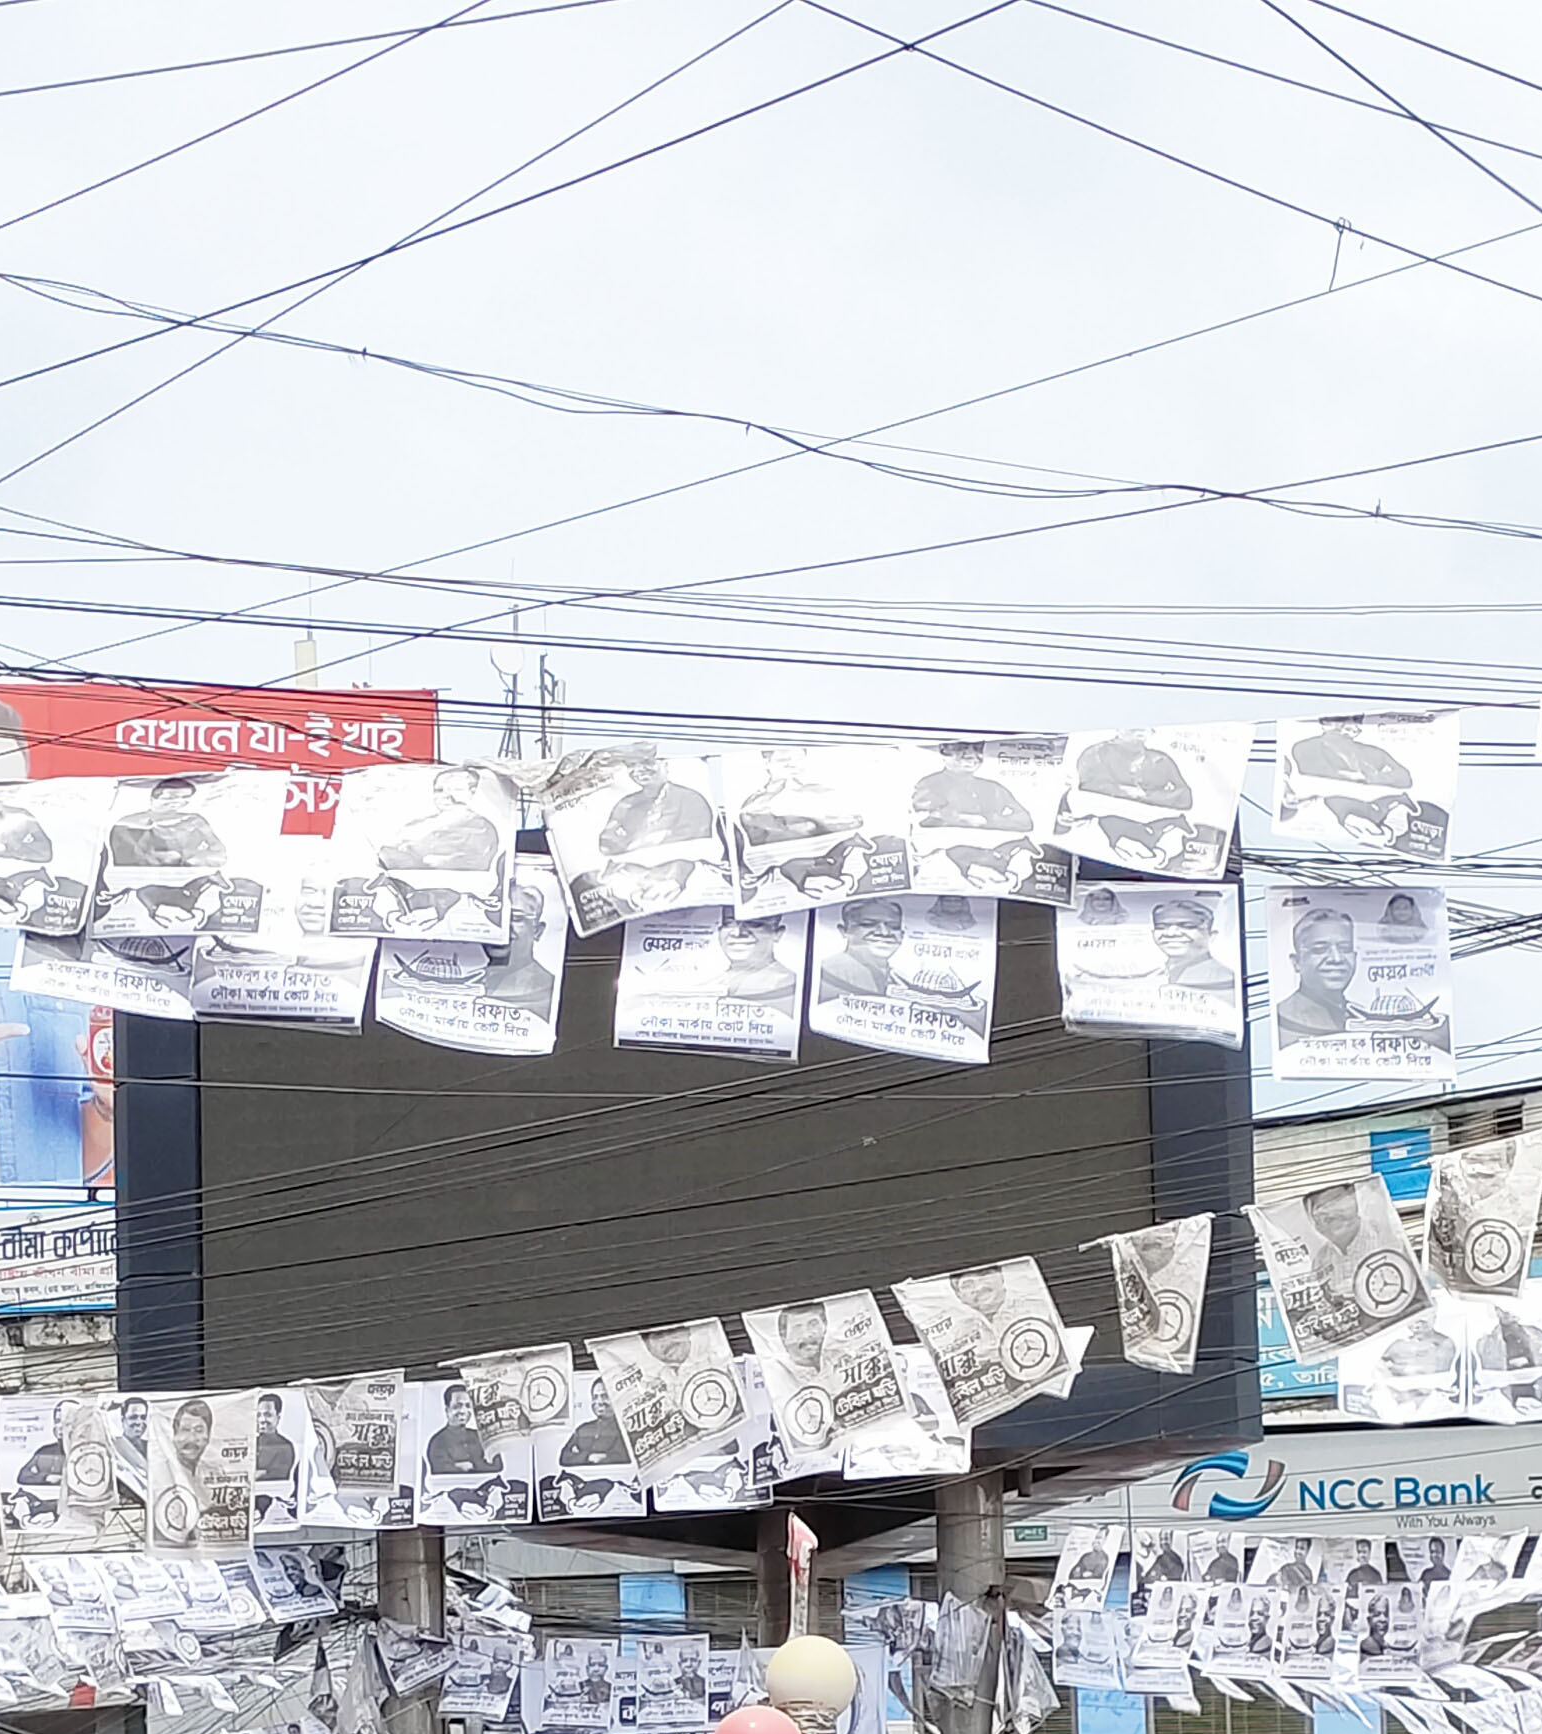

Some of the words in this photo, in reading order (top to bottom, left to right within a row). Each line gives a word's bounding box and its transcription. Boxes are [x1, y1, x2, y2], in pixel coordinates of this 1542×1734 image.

[115, 718, 241, 753] যেখানে
[341, 713, 407, 758] খাই
[869, 852, 904, 868] ঘোড়া
[1034, 861, 1069, 878] ঘোড়া
[222, 894, 258, 910] ঘোড়া
[339, 894, 375, 910] ঘোড়া
[113, 968, 165, 993] রিফাত
[283, 966, 332, 988] রিফাত
[1367, 964, 1408, 982] মেয়র
[472, 999, 522, 1023] রিফাত
[909, 1002, 958, 1030] রিফাত
[1370, 1033, 1421, 1053] রিফাত
[0, 1226, 46, 1260] বীমা
[1299, 1478, 1385, 1511] NCC
[1394, 1473, 1497, 1508] Bank
[1395, 1514, 1425, 1529] With
